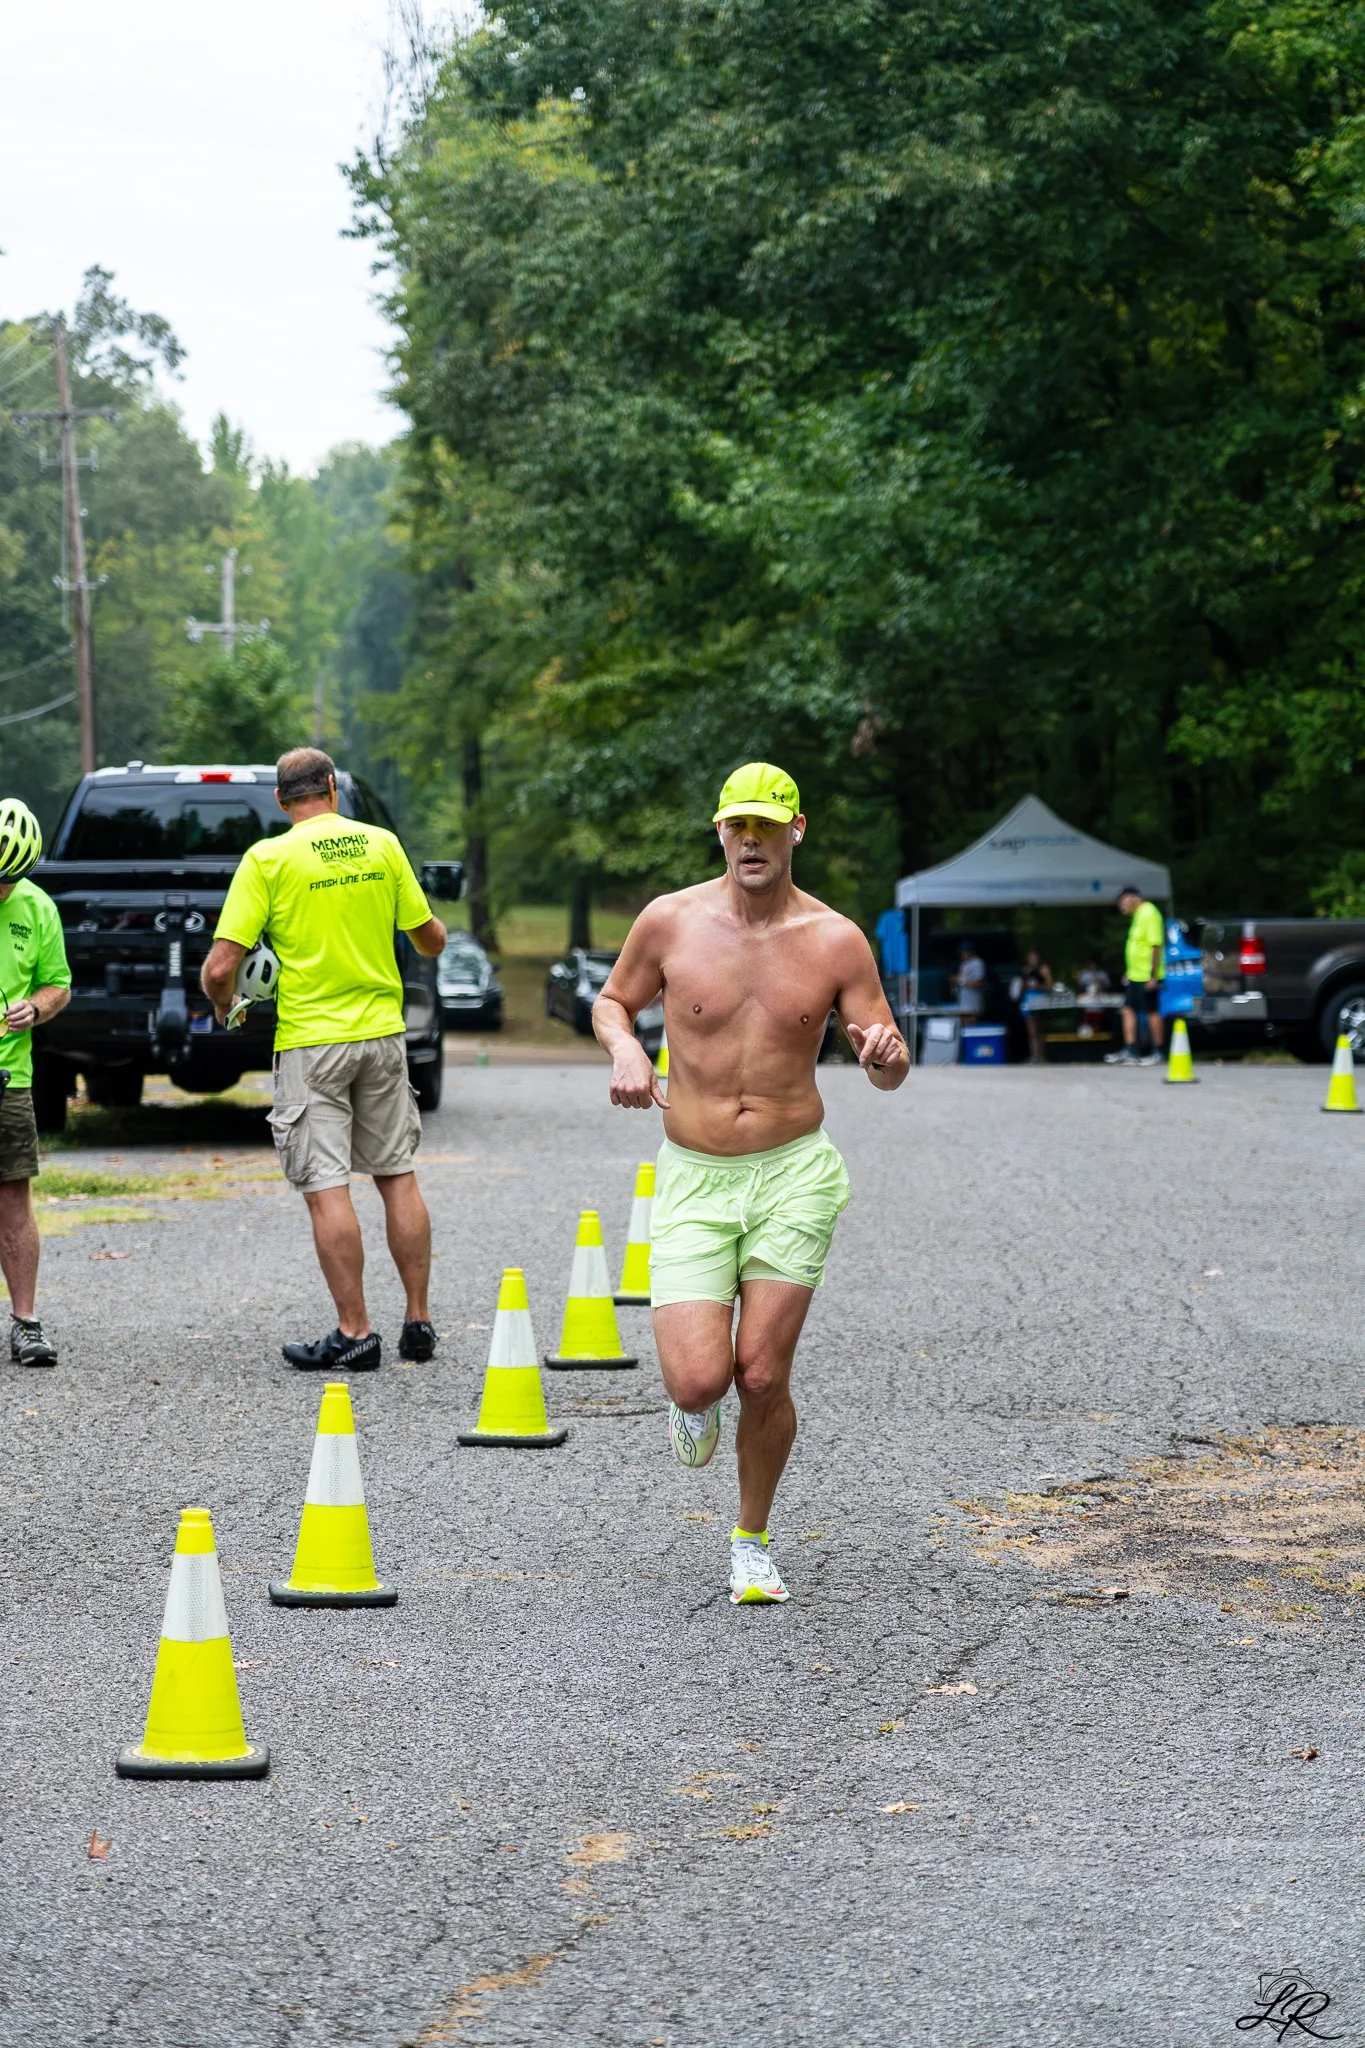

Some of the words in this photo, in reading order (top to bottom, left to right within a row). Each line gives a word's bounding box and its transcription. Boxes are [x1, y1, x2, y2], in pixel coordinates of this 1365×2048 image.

[311, 834, 369, 852] MEMPHIS
[320, 846, 366, 860] RUNNERS
[310, 878, 338, 891] FINISH
[340, 874, 359, 885] LINE
[361, 872, 386, 881] CREW
[169, 941, 181, 977] THULE
